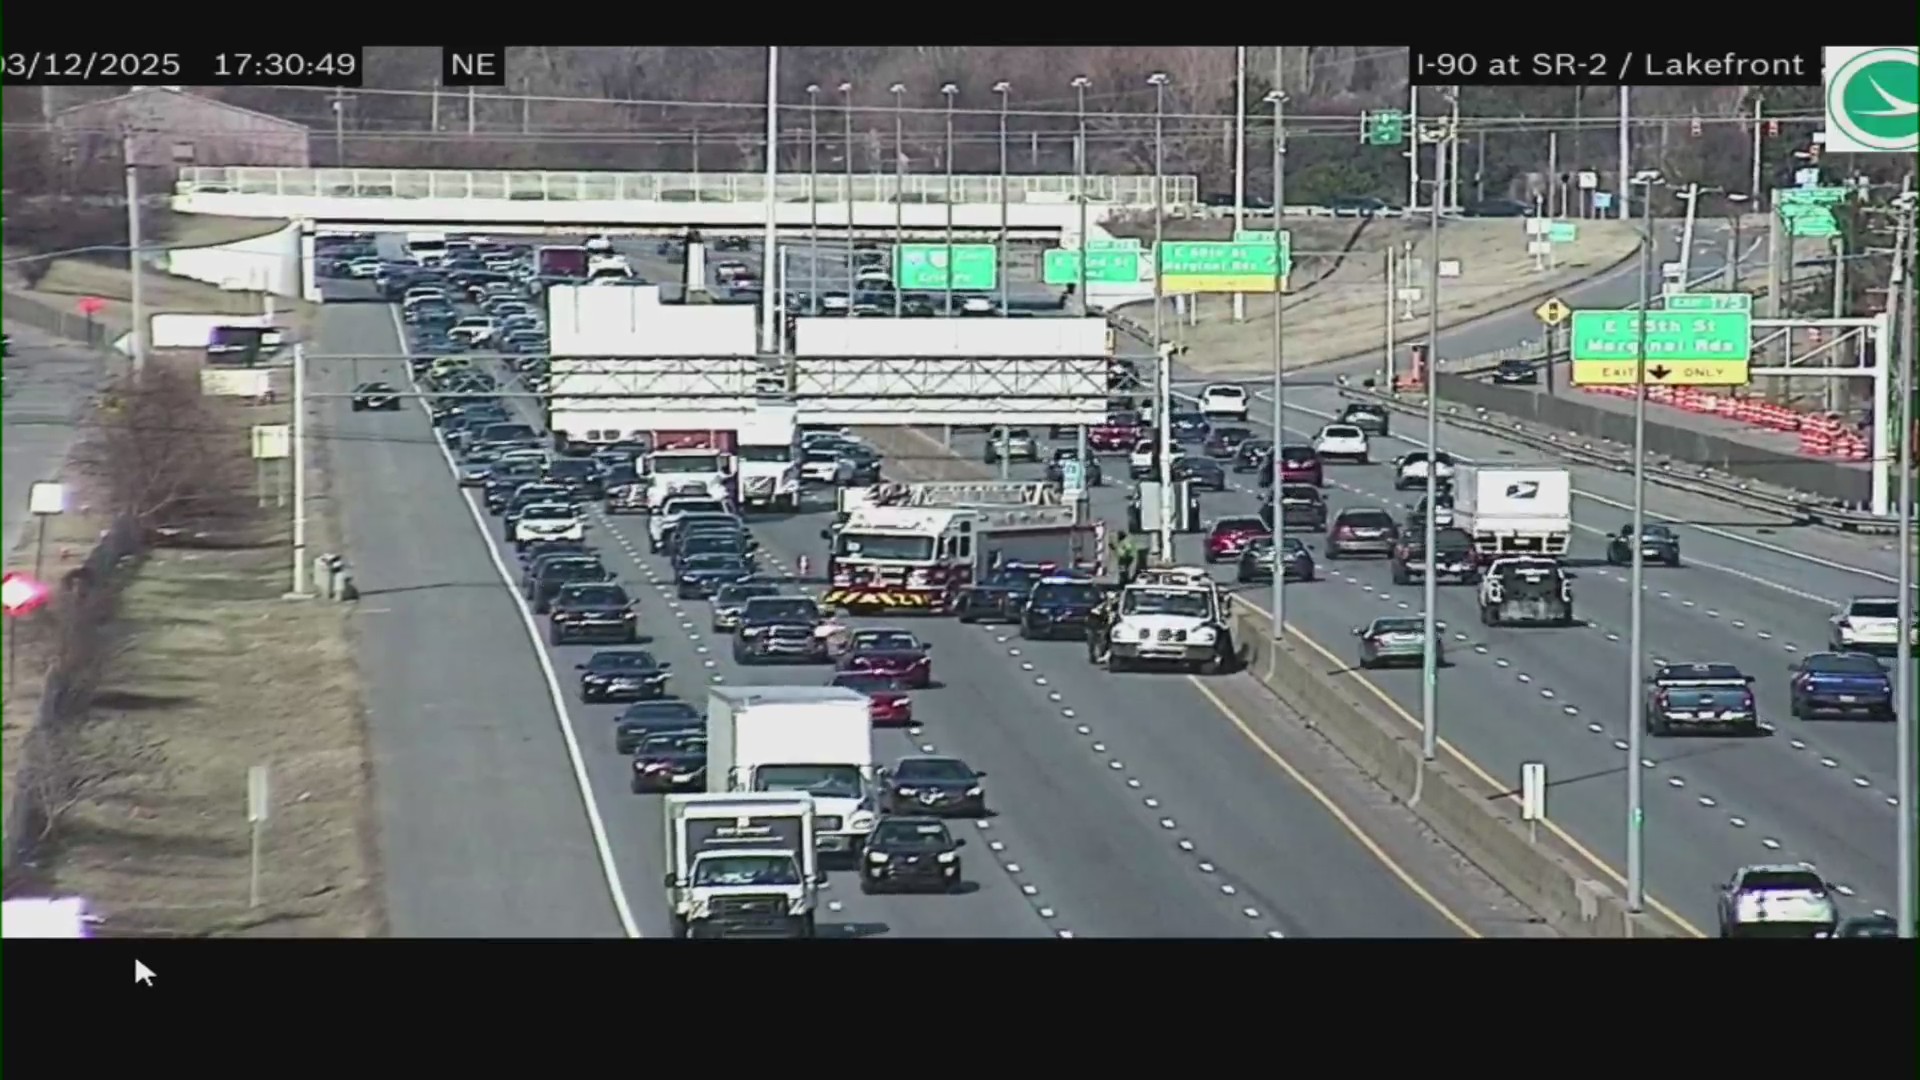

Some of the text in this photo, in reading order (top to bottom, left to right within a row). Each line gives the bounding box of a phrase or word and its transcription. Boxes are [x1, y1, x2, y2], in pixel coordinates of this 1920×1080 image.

[1604, 318, 1717, 333] E 55th St
[1586, 337, 1734, 355] Margnal Rds
[1601, 366, 1725, 378] EXIT ONLY
